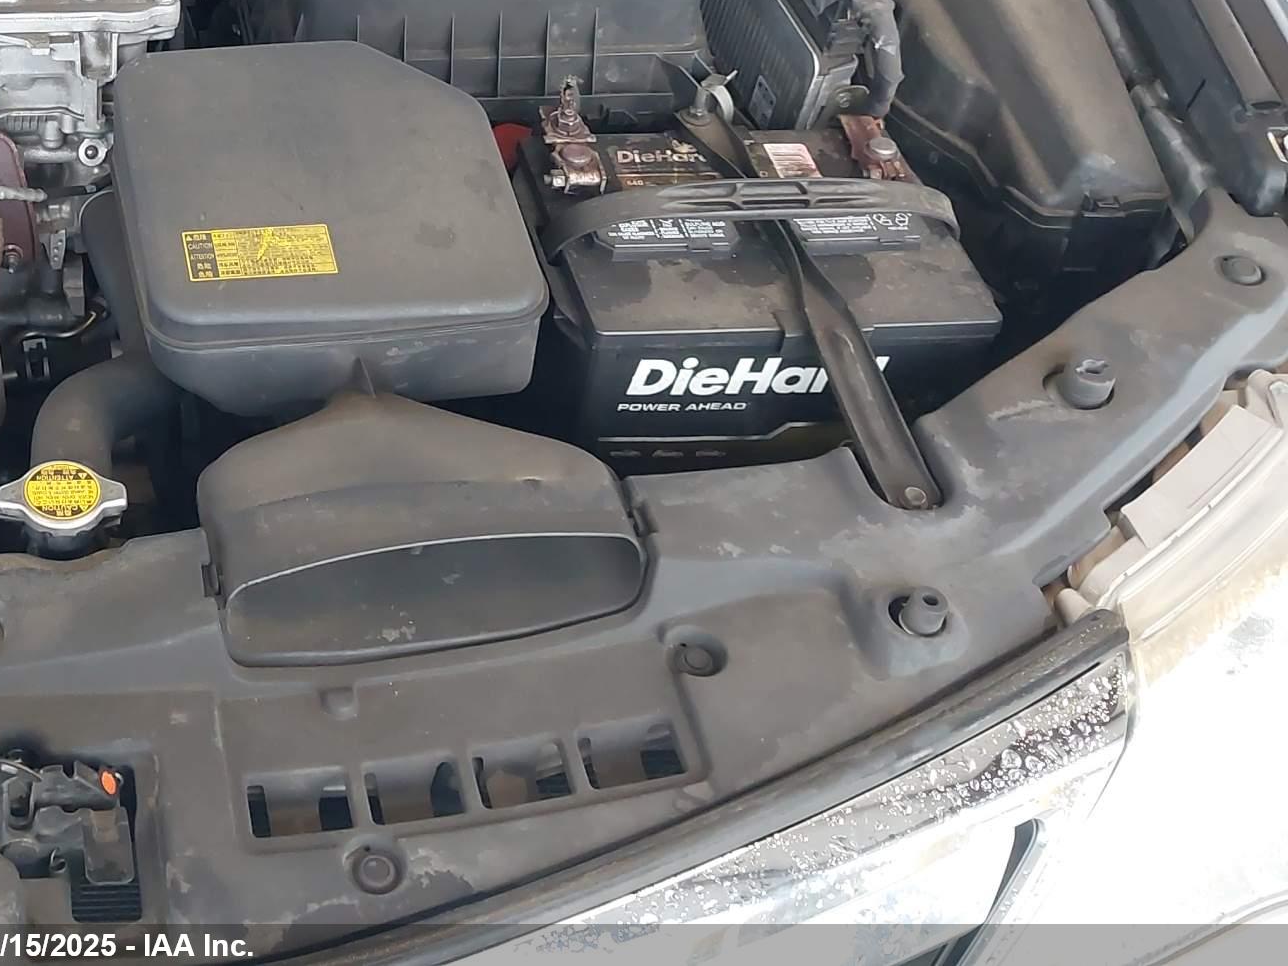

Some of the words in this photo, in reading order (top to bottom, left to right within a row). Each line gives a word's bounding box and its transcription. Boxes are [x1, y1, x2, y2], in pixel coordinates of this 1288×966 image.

[617, 148, 706, 164] DieHar
[625, 355, 890, 397] DieHar
[617, 402, 681, 412] POWER
[684, 401, 747, 411] AHEAD
